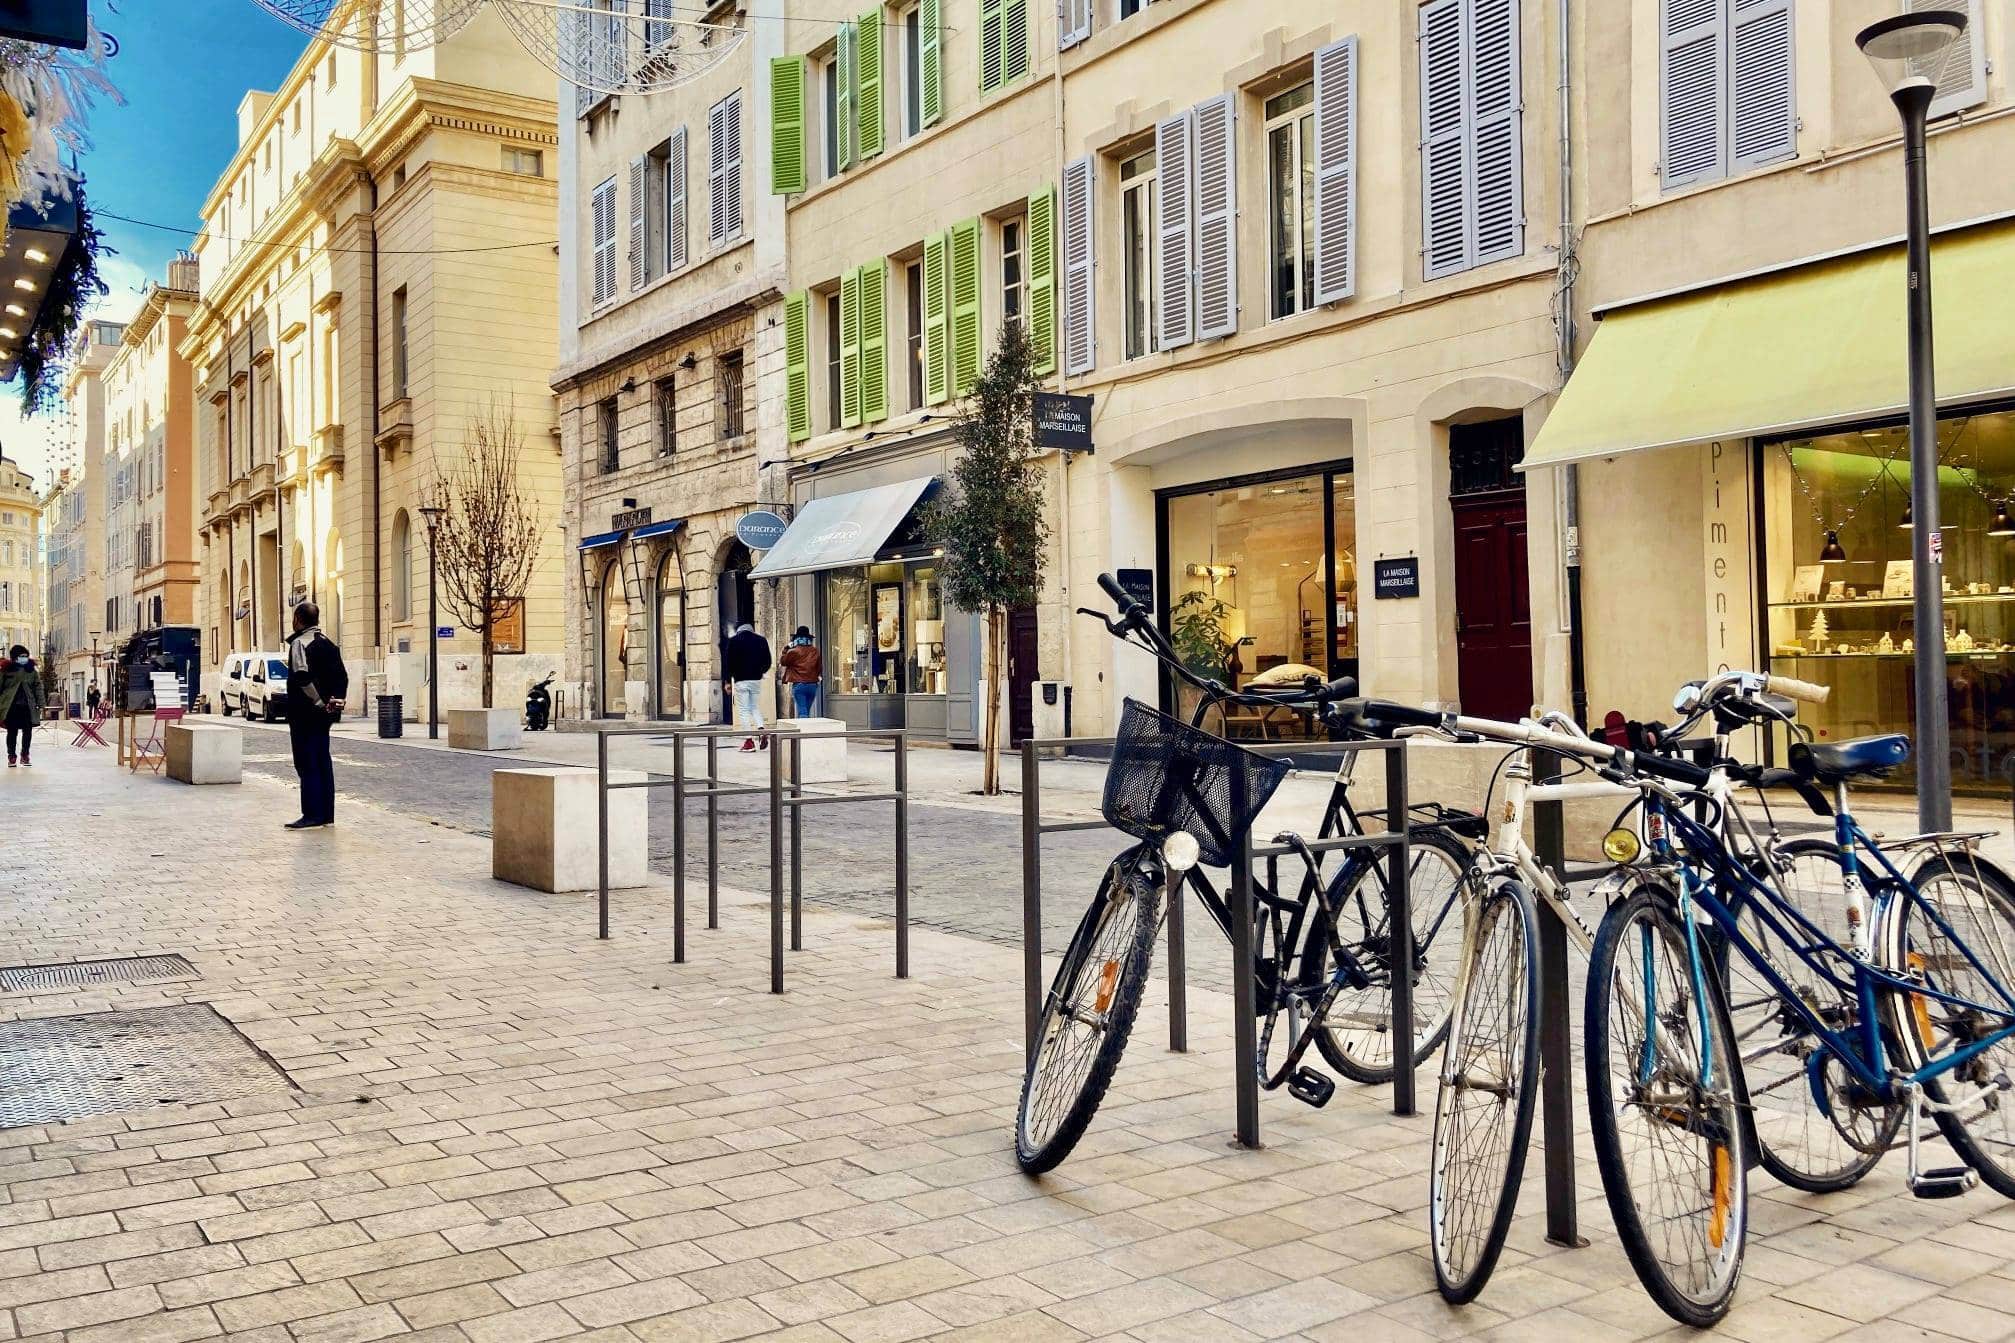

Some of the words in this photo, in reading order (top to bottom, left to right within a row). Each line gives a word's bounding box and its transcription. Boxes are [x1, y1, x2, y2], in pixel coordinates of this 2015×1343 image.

[1055, 412, 1081, 422] MAISON
[1039, 421, 1086, 433] MARSEILLAISE
[1383, 569, 1390, 577] LA
[1391, 568, 1410, 577] MAISON
[1380, 577, 1415, 587] MARSEILLAISE
